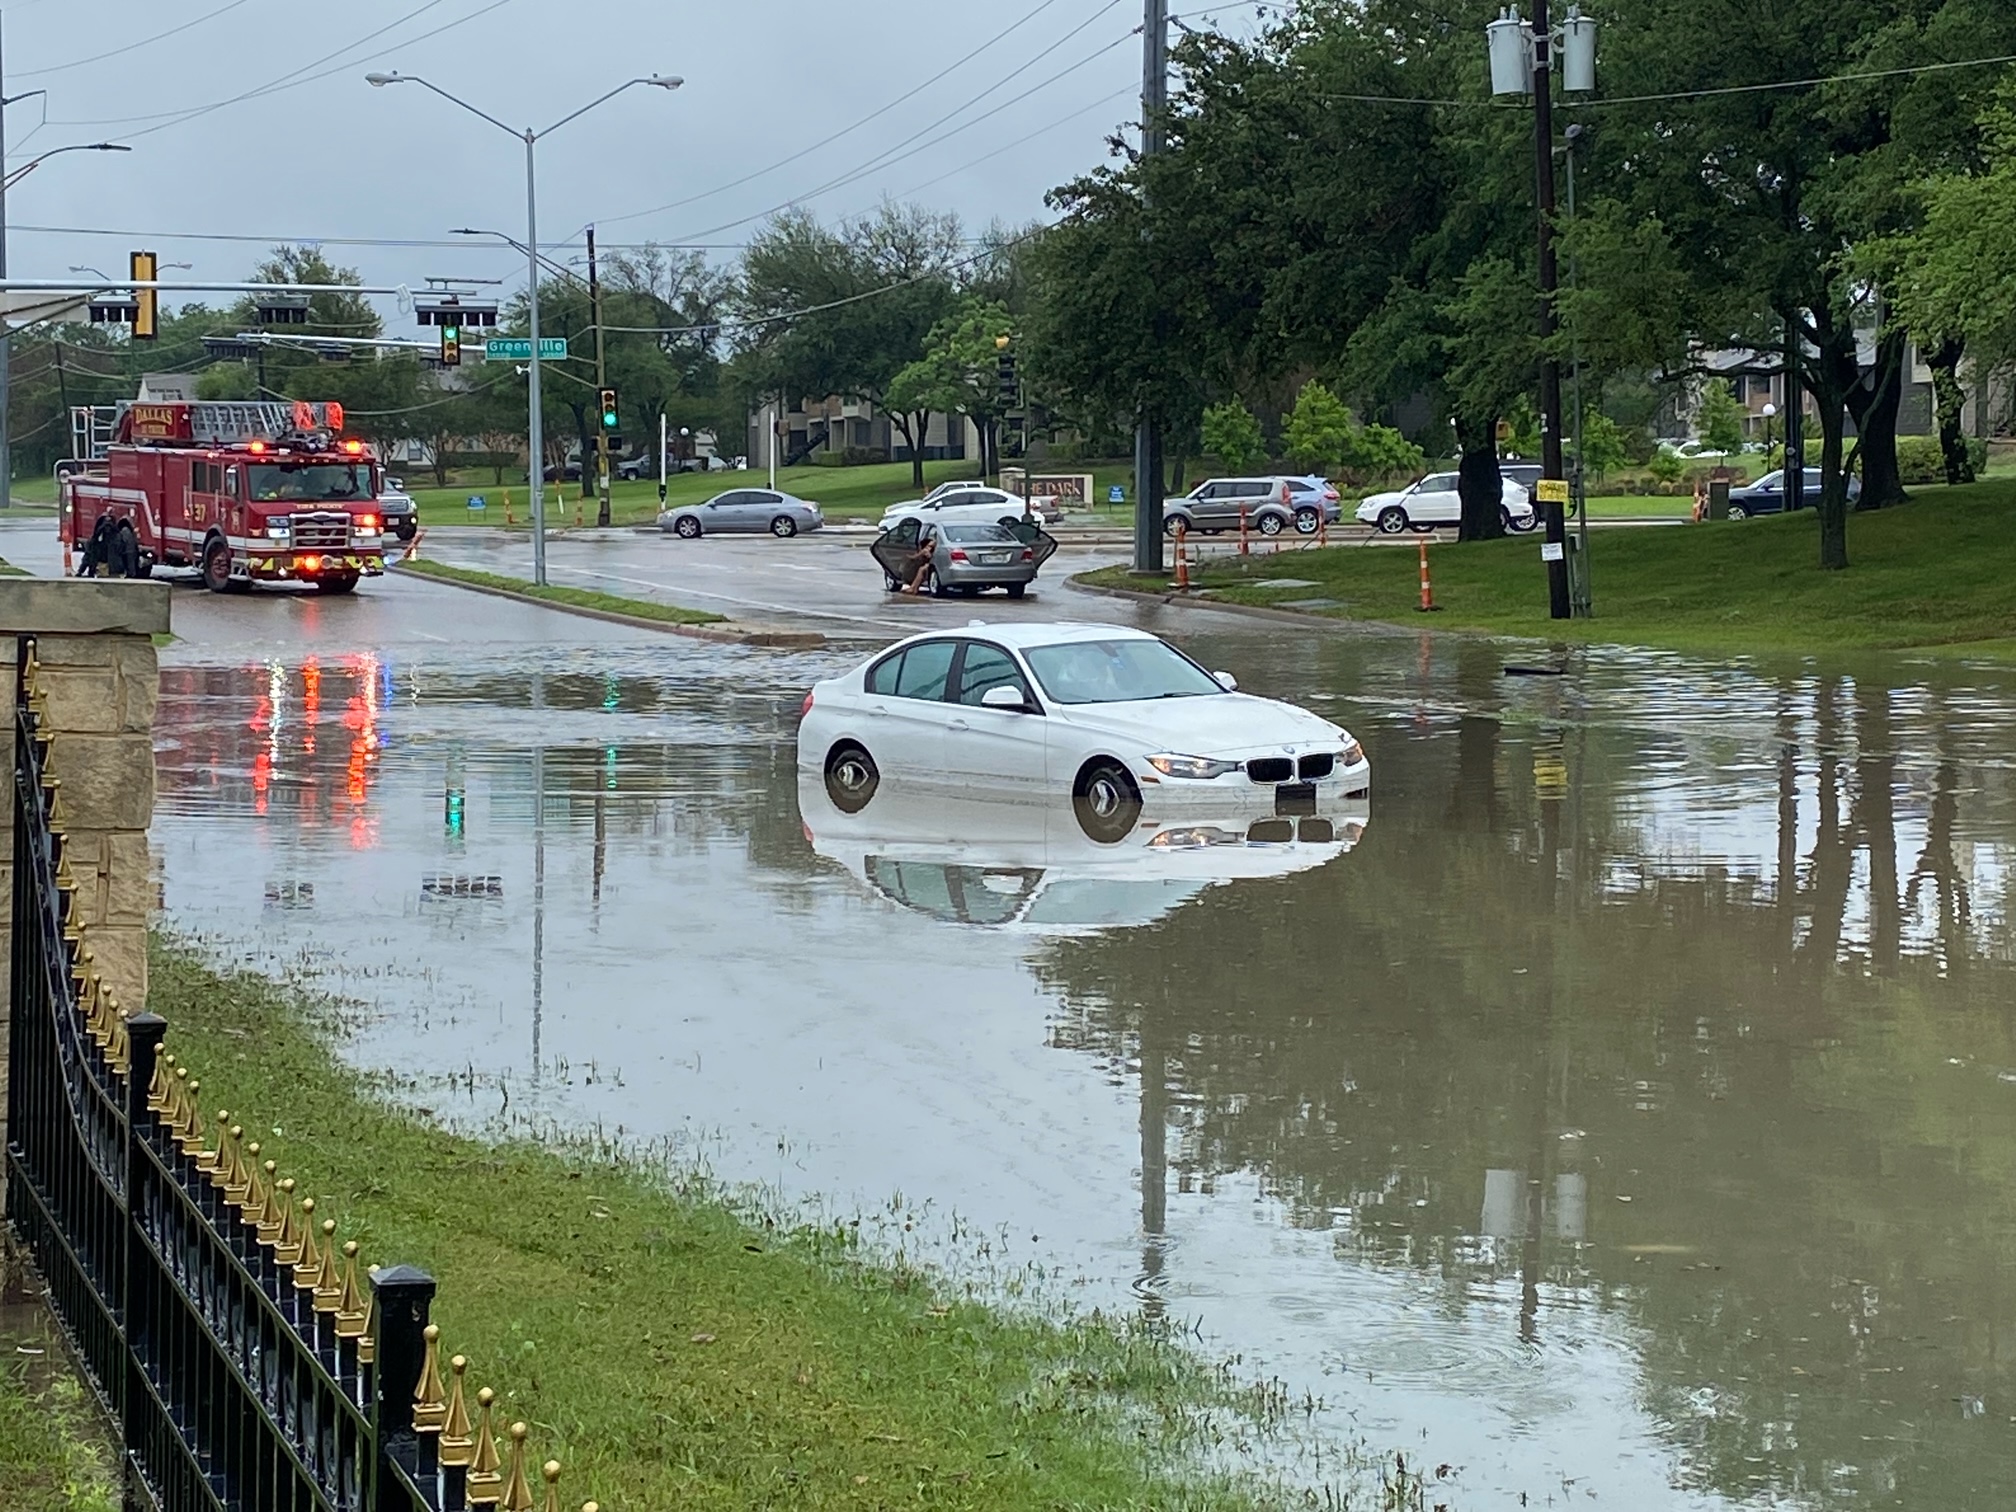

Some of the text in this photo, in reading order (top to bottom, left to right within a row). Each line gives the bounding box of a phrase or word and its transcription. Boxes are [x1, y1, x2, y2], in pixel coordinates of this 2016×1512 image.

[489, 340, 563, 352] Greenille
[135, 408, 173, 425] DALLAS
[194, 503, 206, 522] 37
